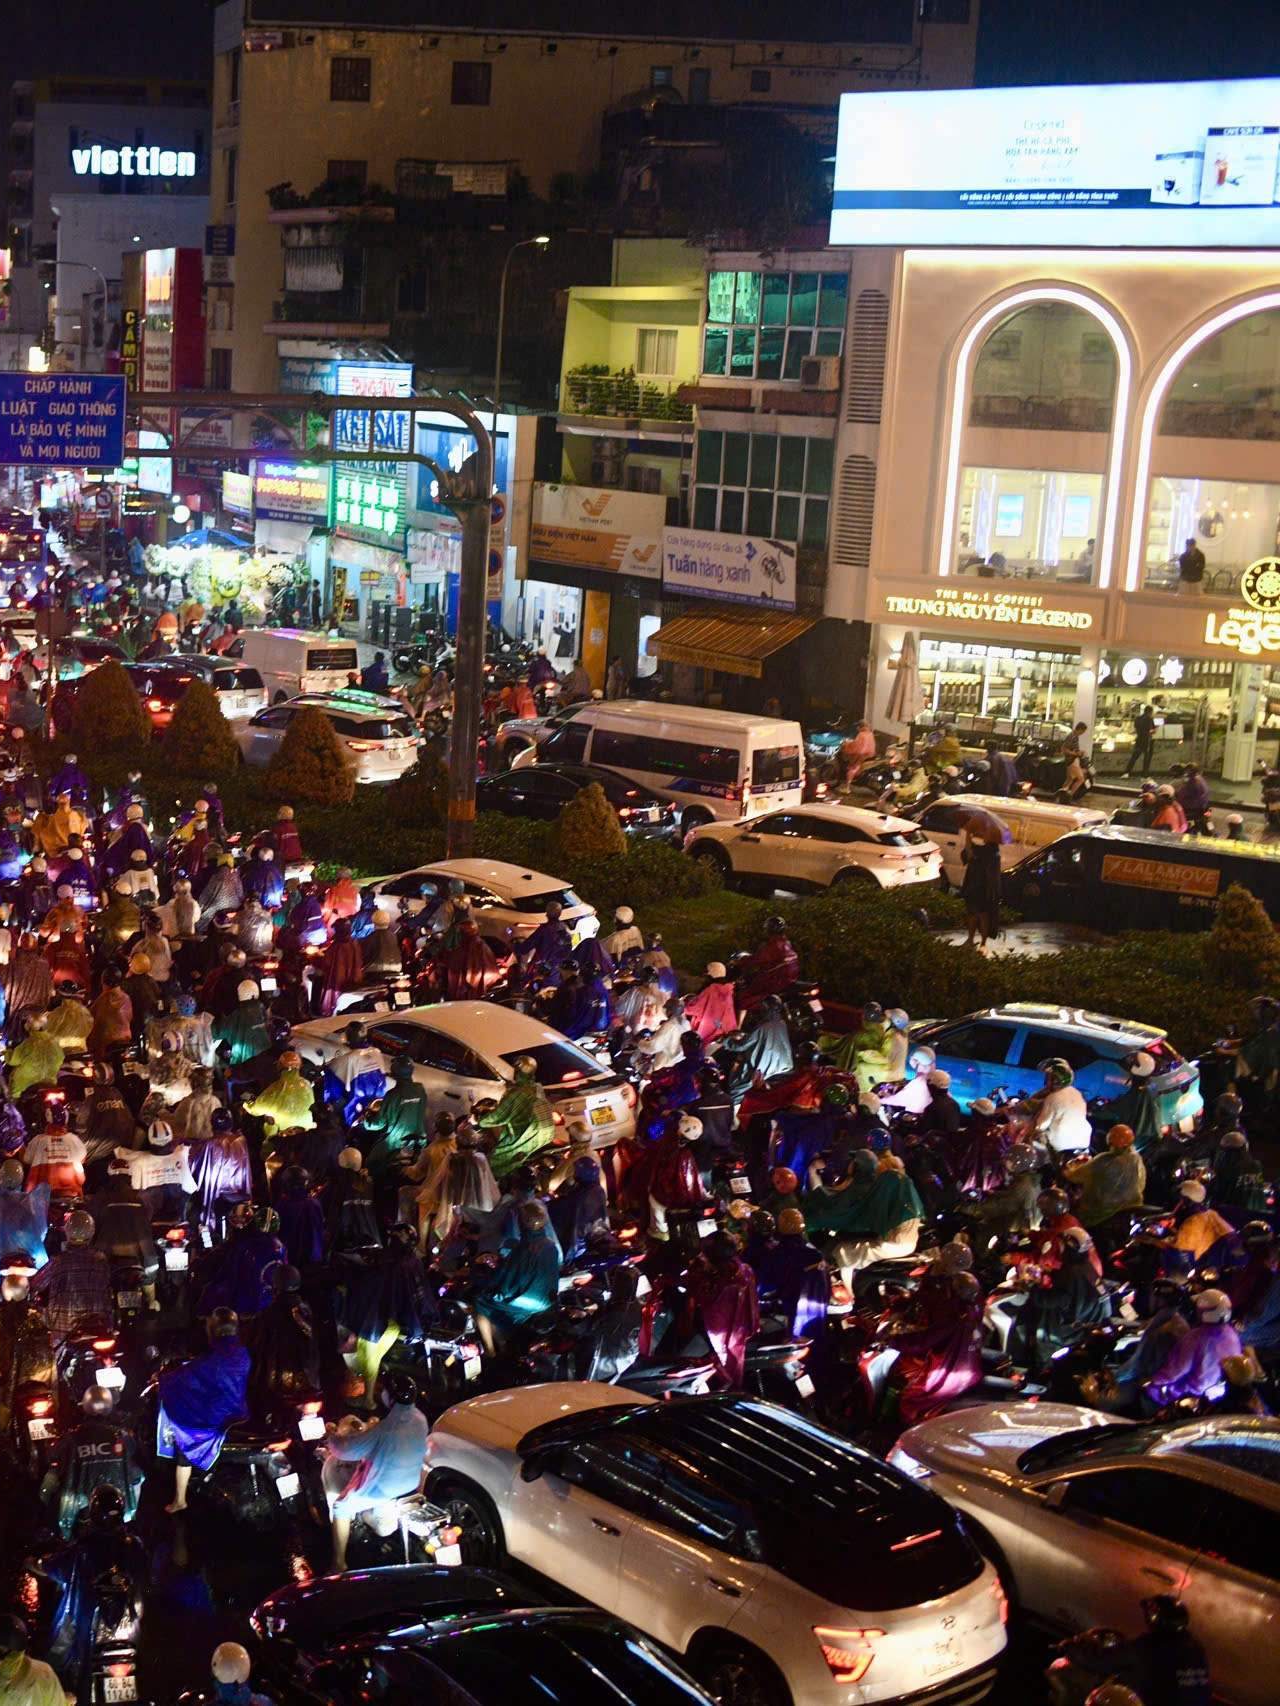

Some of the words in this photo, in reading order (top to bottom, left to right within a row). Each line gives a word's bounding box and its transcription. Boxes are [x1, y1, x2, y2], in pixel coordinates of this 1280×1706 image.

[72, 145, 196, 177] viettien
[24, 376, 56, 393] CHẤP
[59, 377, 92, 395] HÀNH
[1, 399, 37, 418] LUẬT
[48, 401, 76, 416] GIAO
[79, 400, 117, 417] THÔNG
[10, 419, 26, 436] LÀ
[29, 418, 53, 437] BẢO
[57, 421, 73, 440] VỆ
[75, 420, 107, 438] MÌNH
[38, 445, 60, 461] MỌI
[64, 440, 101, 459] NGƯỜI
[667, 552, 698, 575] Tuấn
[699, 557, 724, 584] hàng
[725, 563, 751, 583] xanh
[935, 588, 958, 600] THE
[886, 596, 945, 617] TRUNG
[946, 601, 1020, 624] NGUYÊN
[1020, 608, 1093, 630] LEGEND
[1123, 862, 1216, 888] LALAMOVE
[76, 1442, 111, 1459] BIC
